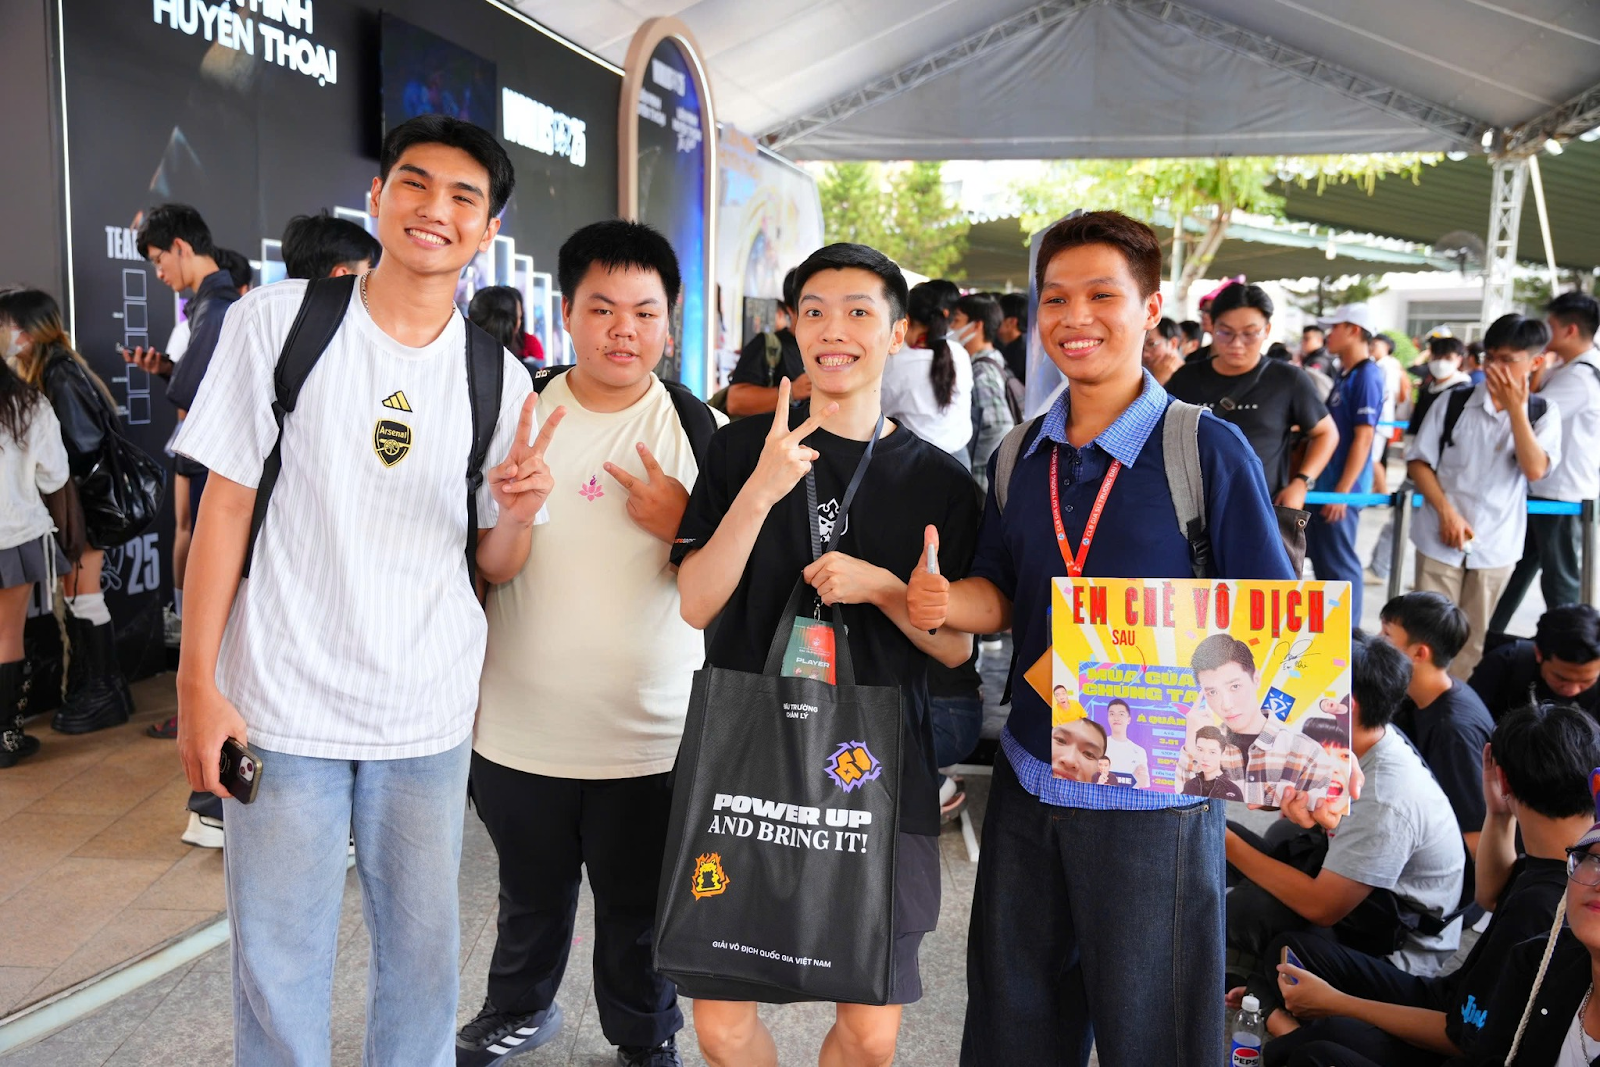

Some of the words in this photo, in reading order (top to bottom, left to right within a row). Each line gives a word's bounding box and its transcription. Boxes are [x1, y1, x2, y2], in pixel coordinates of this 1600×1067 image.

[380, 425, 407, 439] Arsenal
[1086, 524, 1094, 537] CLB
[1091, 513, 1099, 525] GIA
[126, 532, 160, 596] 25
[1073, 586, 1107, 625] EM
[1125, 581, 1175, 628] CHÈ
[1192, 583, 1230, 629] VÔ
[1112, 630, 1135, 646] SAU
[796, 657, 830, 668] PLAYER
[1082, 683, 1162, 701] CHÚNG
[1166, 689, 1199, 703] TA
[712, 793, 820, 826] POWER
[825, 808, 872, 828] UP
[708, 815, 754, 838] AND
[757, 821, 829, 851] BRING
[834, 831, 869, 854] IT!
[712, 940, 728, 949] GIẢI
[729, 942, 740, 951] VÔ
[740, 945, 759, 955] ĐỊCH
[759, 949, 780, 960] QUỐC
[781, 954, 794, 963] GIA
[795, 956, 812, 966] VIỆT
[813, 959, 831, 968] NAM
